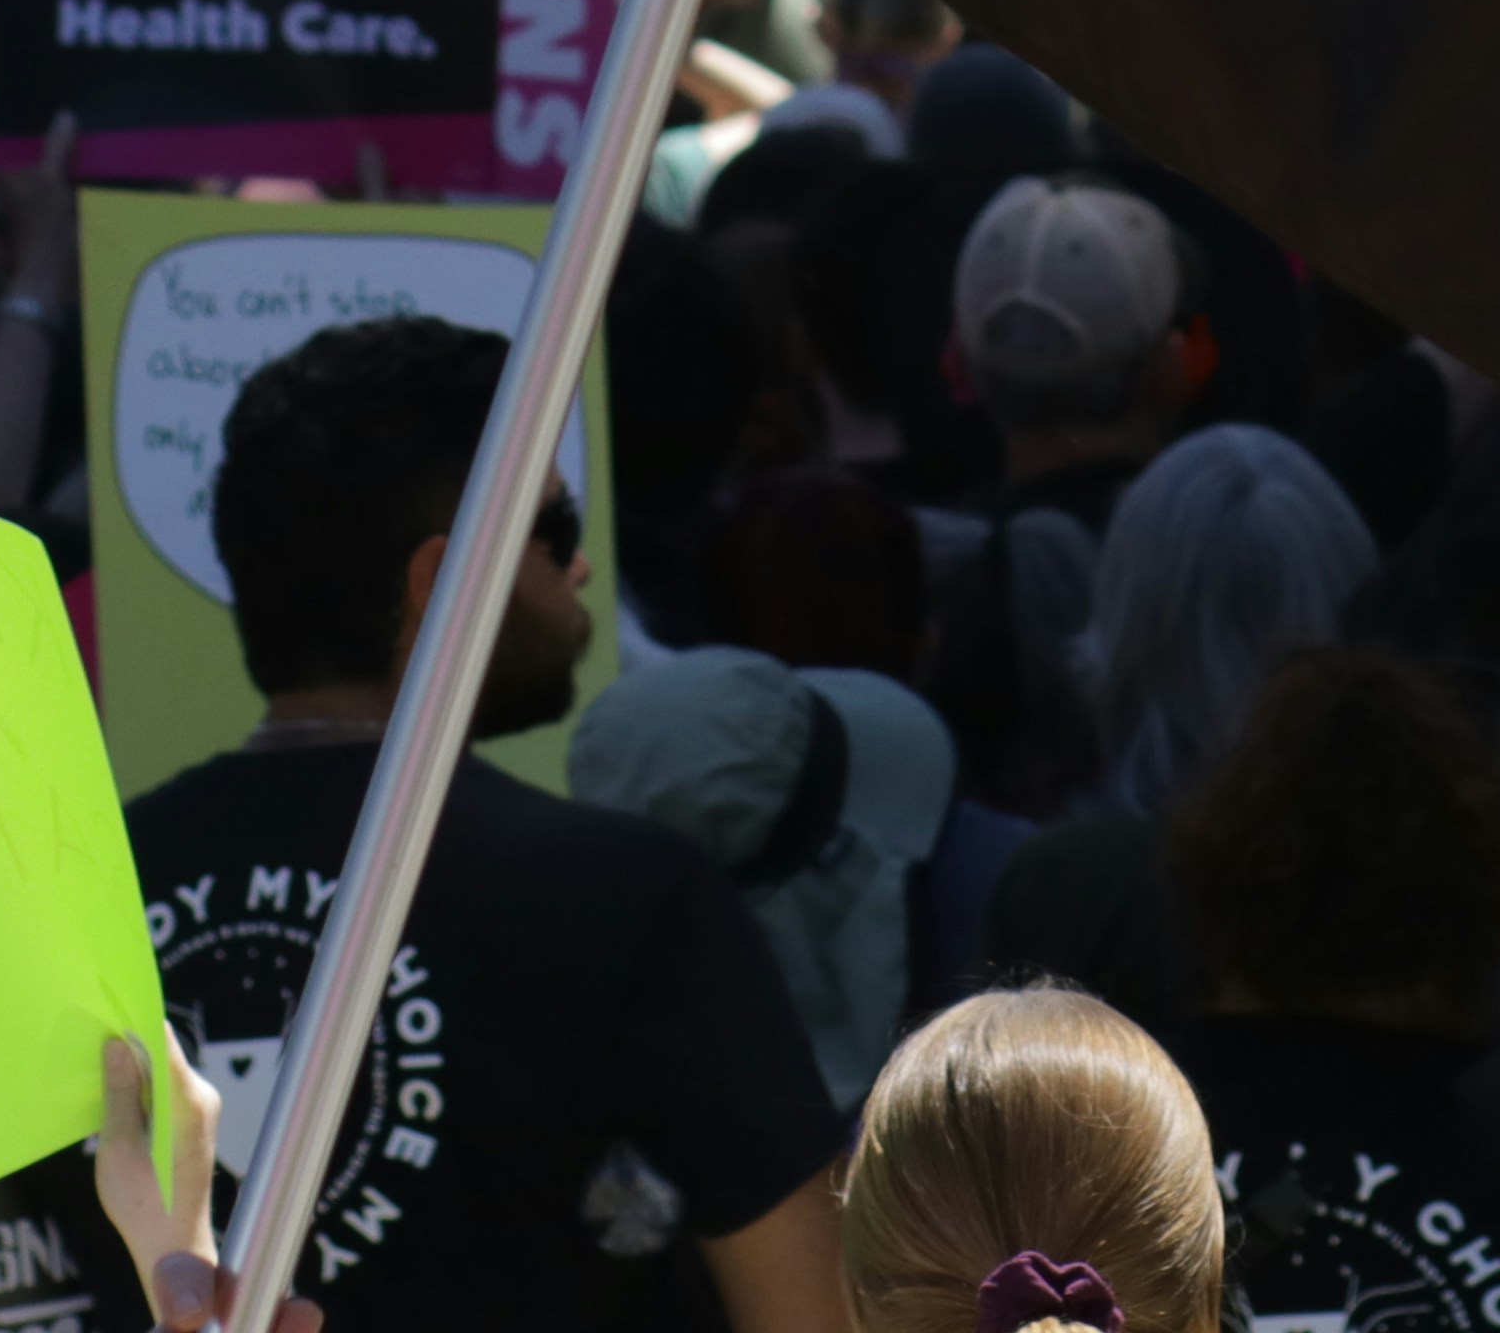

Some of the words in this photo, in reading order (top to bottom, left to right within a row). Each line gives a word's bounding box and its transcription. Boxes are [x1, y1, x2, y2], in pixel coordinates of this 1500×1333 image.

[281, 0, 437, 59] Care.
[146, 343, 268, 385] abor
[246, 864, 341, 920] MY
[384, 944, 443, 1169] HOICE
[312, 1186, 402, 1284] MY
